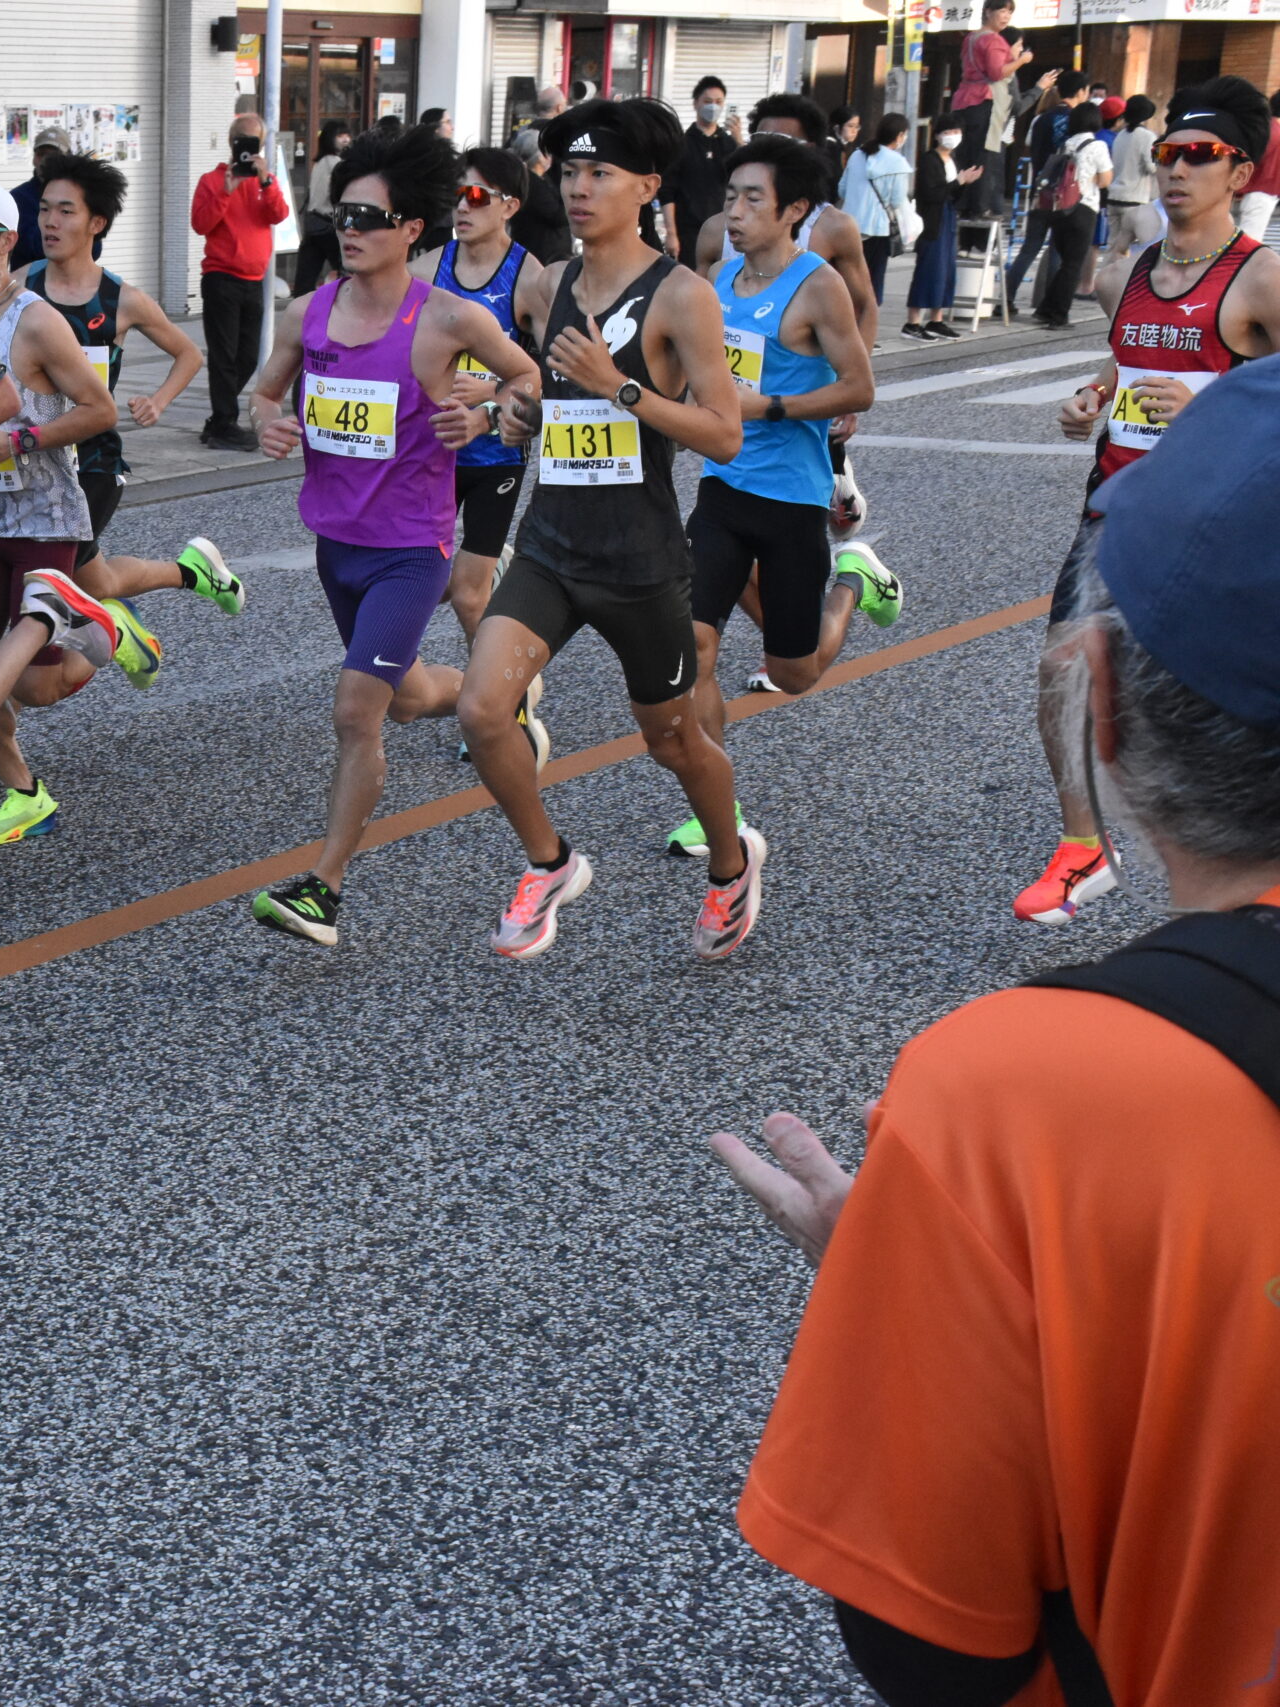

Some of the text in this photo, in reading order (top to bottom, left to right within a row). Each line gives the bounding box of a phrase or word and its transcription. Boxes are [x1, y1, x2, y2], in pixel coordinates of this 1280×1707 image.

[1120, 323, 1203, 351] 友睦物流
[306, 396, 370, 433] A 48
[1112, 391, 1127, 422] A
[542, 423, 613, 458] A 131
